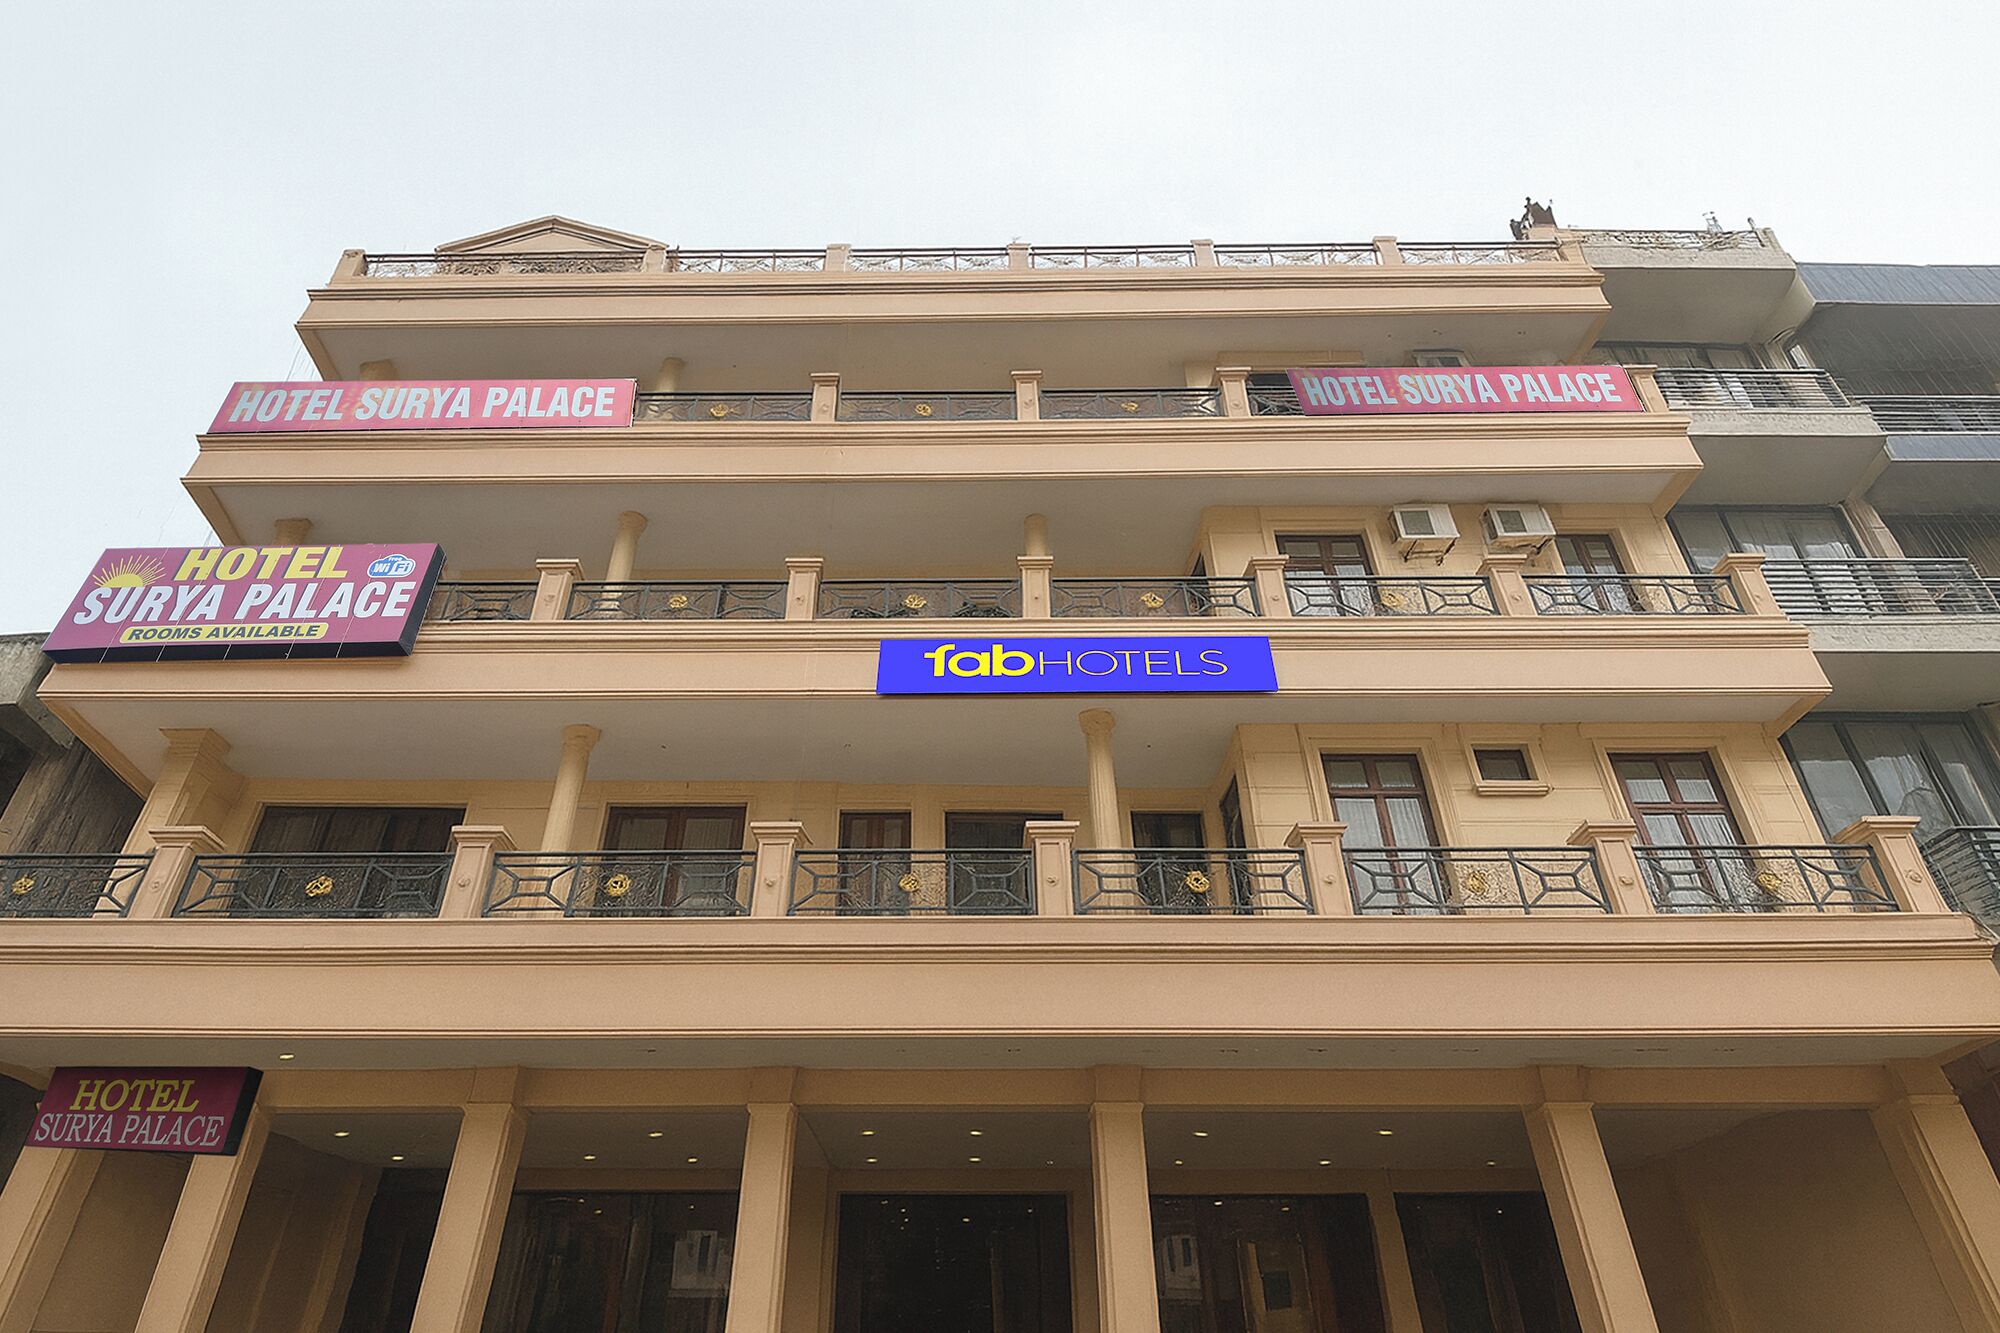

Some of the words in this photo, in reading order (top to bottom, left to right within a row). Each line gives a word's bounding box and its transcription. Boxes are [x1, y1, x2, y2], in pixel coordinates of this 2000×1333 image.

[228, 390, 344, 423] HOTEL
[355, 387, 477, 419] SURYA
[482, 386, 616, 418] PALACE
[1302, 376, 1399, 406] HOTEL
[1397, 374, 1501, 405] SURYA
[1499, 373, 1623, 403] PALACE
[173, 546, 348, 582] HOTEL
[73, 584, 225, 625] SURYA
[234, 581, 417, 620] PALACE
[127, 627, 201, 641] ROOMS
[206, 624, 321, 639] AVAILABLE
[69, 1079, 199, 1112] HOTEL
[34, 1113, 114, 1144] SURYA
[118, 1115, 225, 1147] PALACE
